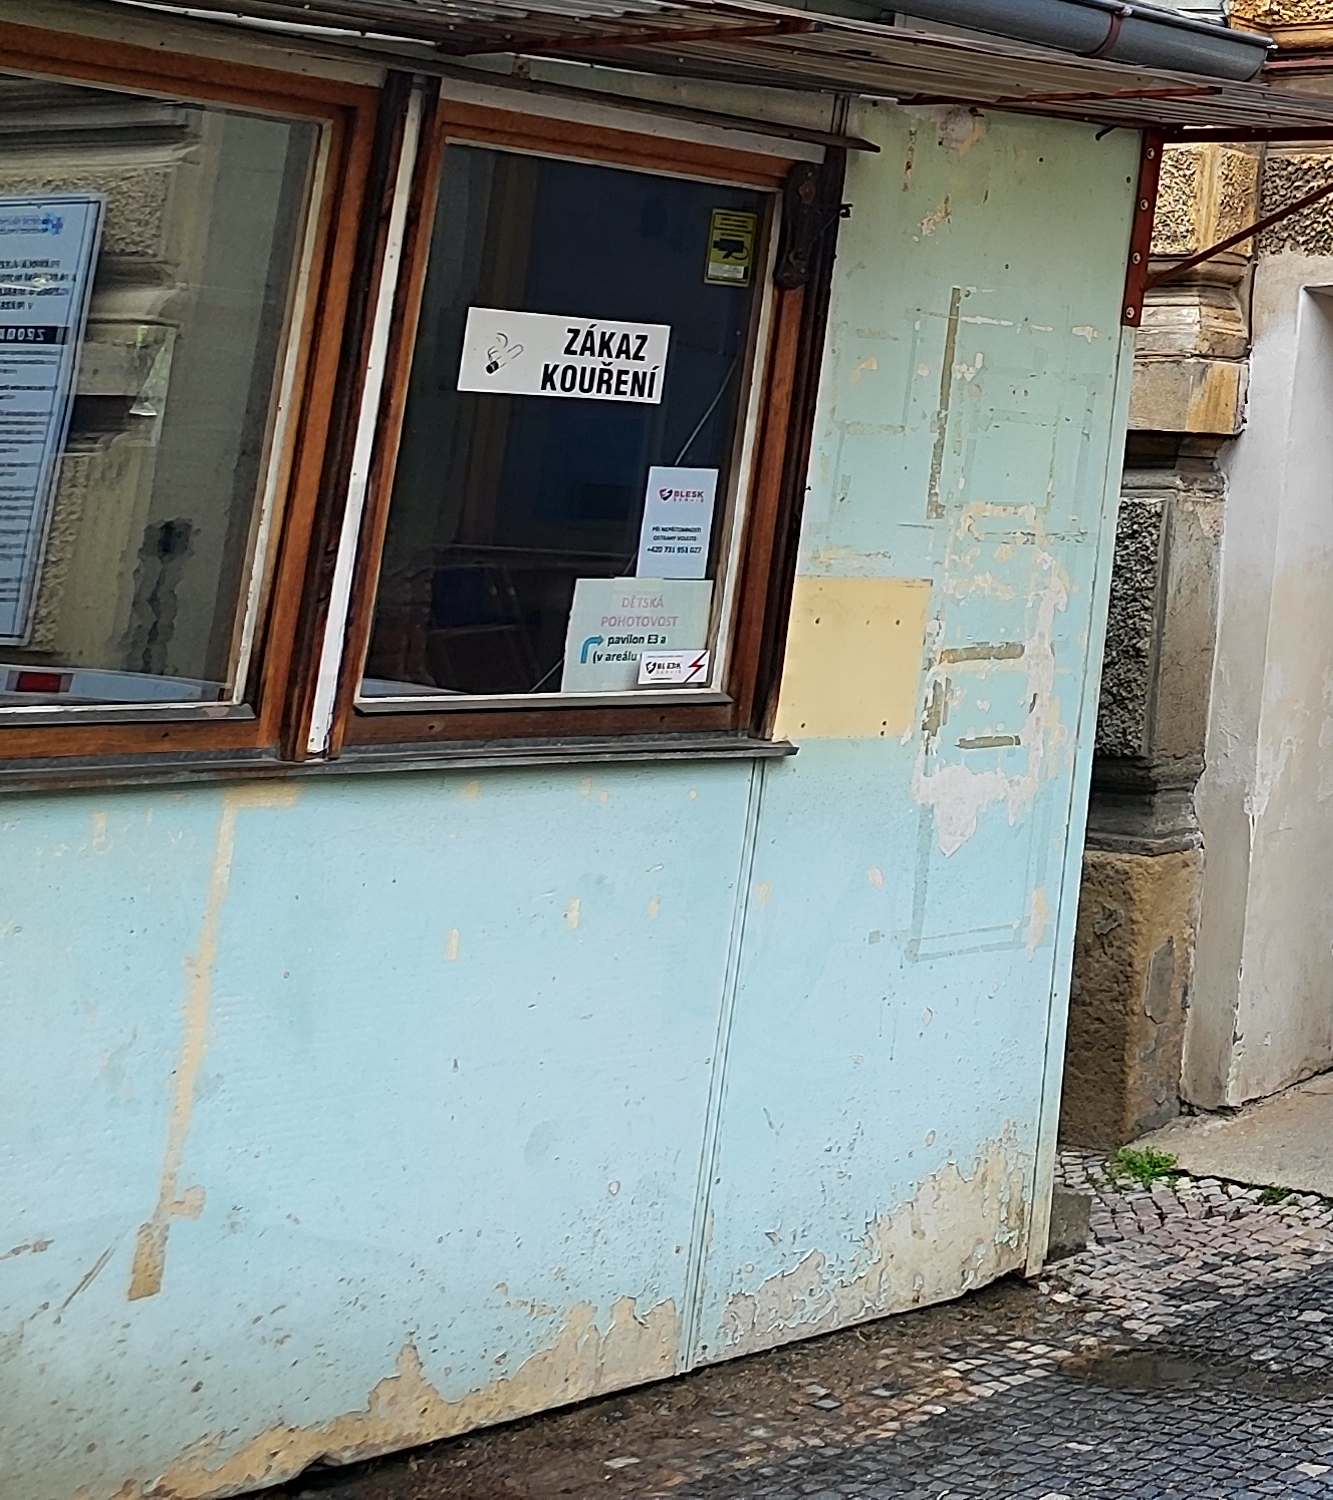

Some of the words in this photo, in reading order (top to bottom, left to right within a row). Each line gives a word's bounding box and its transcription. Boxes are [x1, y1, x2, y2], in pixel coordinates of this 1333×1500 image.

[563, 323, 649, 361] ZÁKAZ
[540, 361, 660, 398] KOUŘENÍ
[622, 595, 664, 609] DĚTSKÁ
[601, 616, 678, 628] POHOTOVOST
[607, 634, 645, 647] pavilon
[605, 651, 637, 662] areálu
